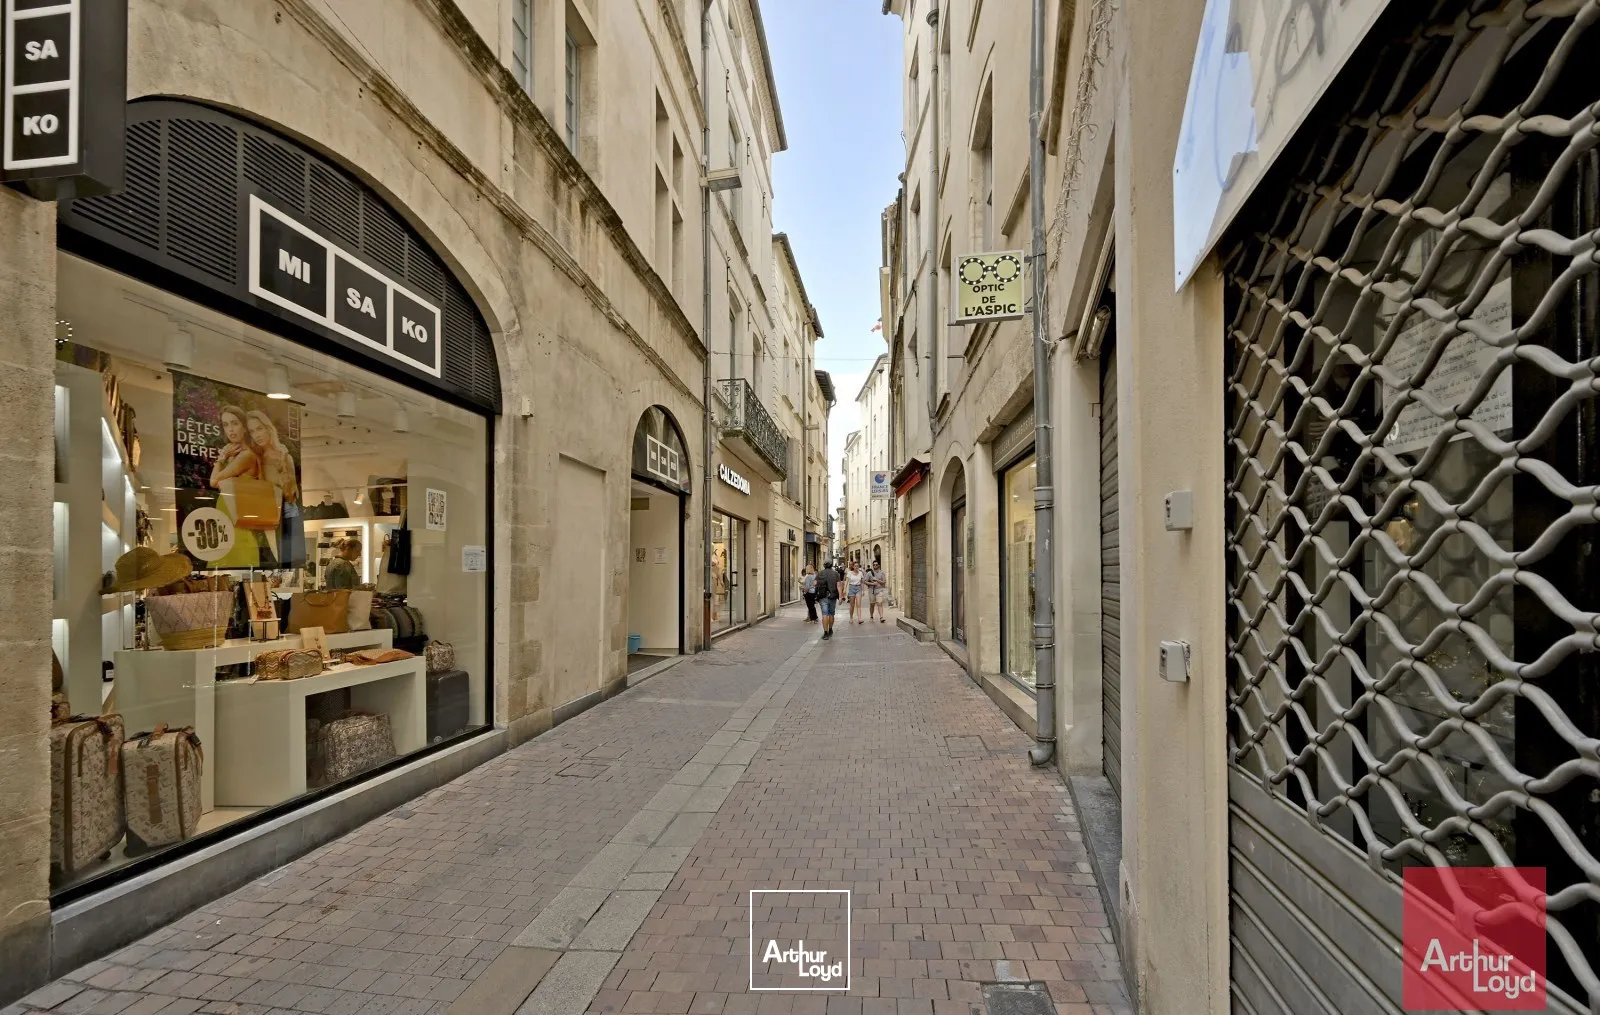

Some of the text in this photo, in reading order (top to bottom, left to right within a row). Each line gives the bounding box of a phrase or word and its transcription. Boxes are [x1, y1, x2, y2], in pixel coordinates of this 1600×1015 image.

[24, 39, 59, 61] SA
[22, 113, 59, 136] KO
[278, 248, 428, 345] MI SA KO
[972, 283, 1005, 293] OPTIC
[981, 295, 996, 304] DE
[964, 303, 1017, 317] L'ASPIC
[177, 417, 221, 436] FÊTES
[177, 430, 206, 446] DES
